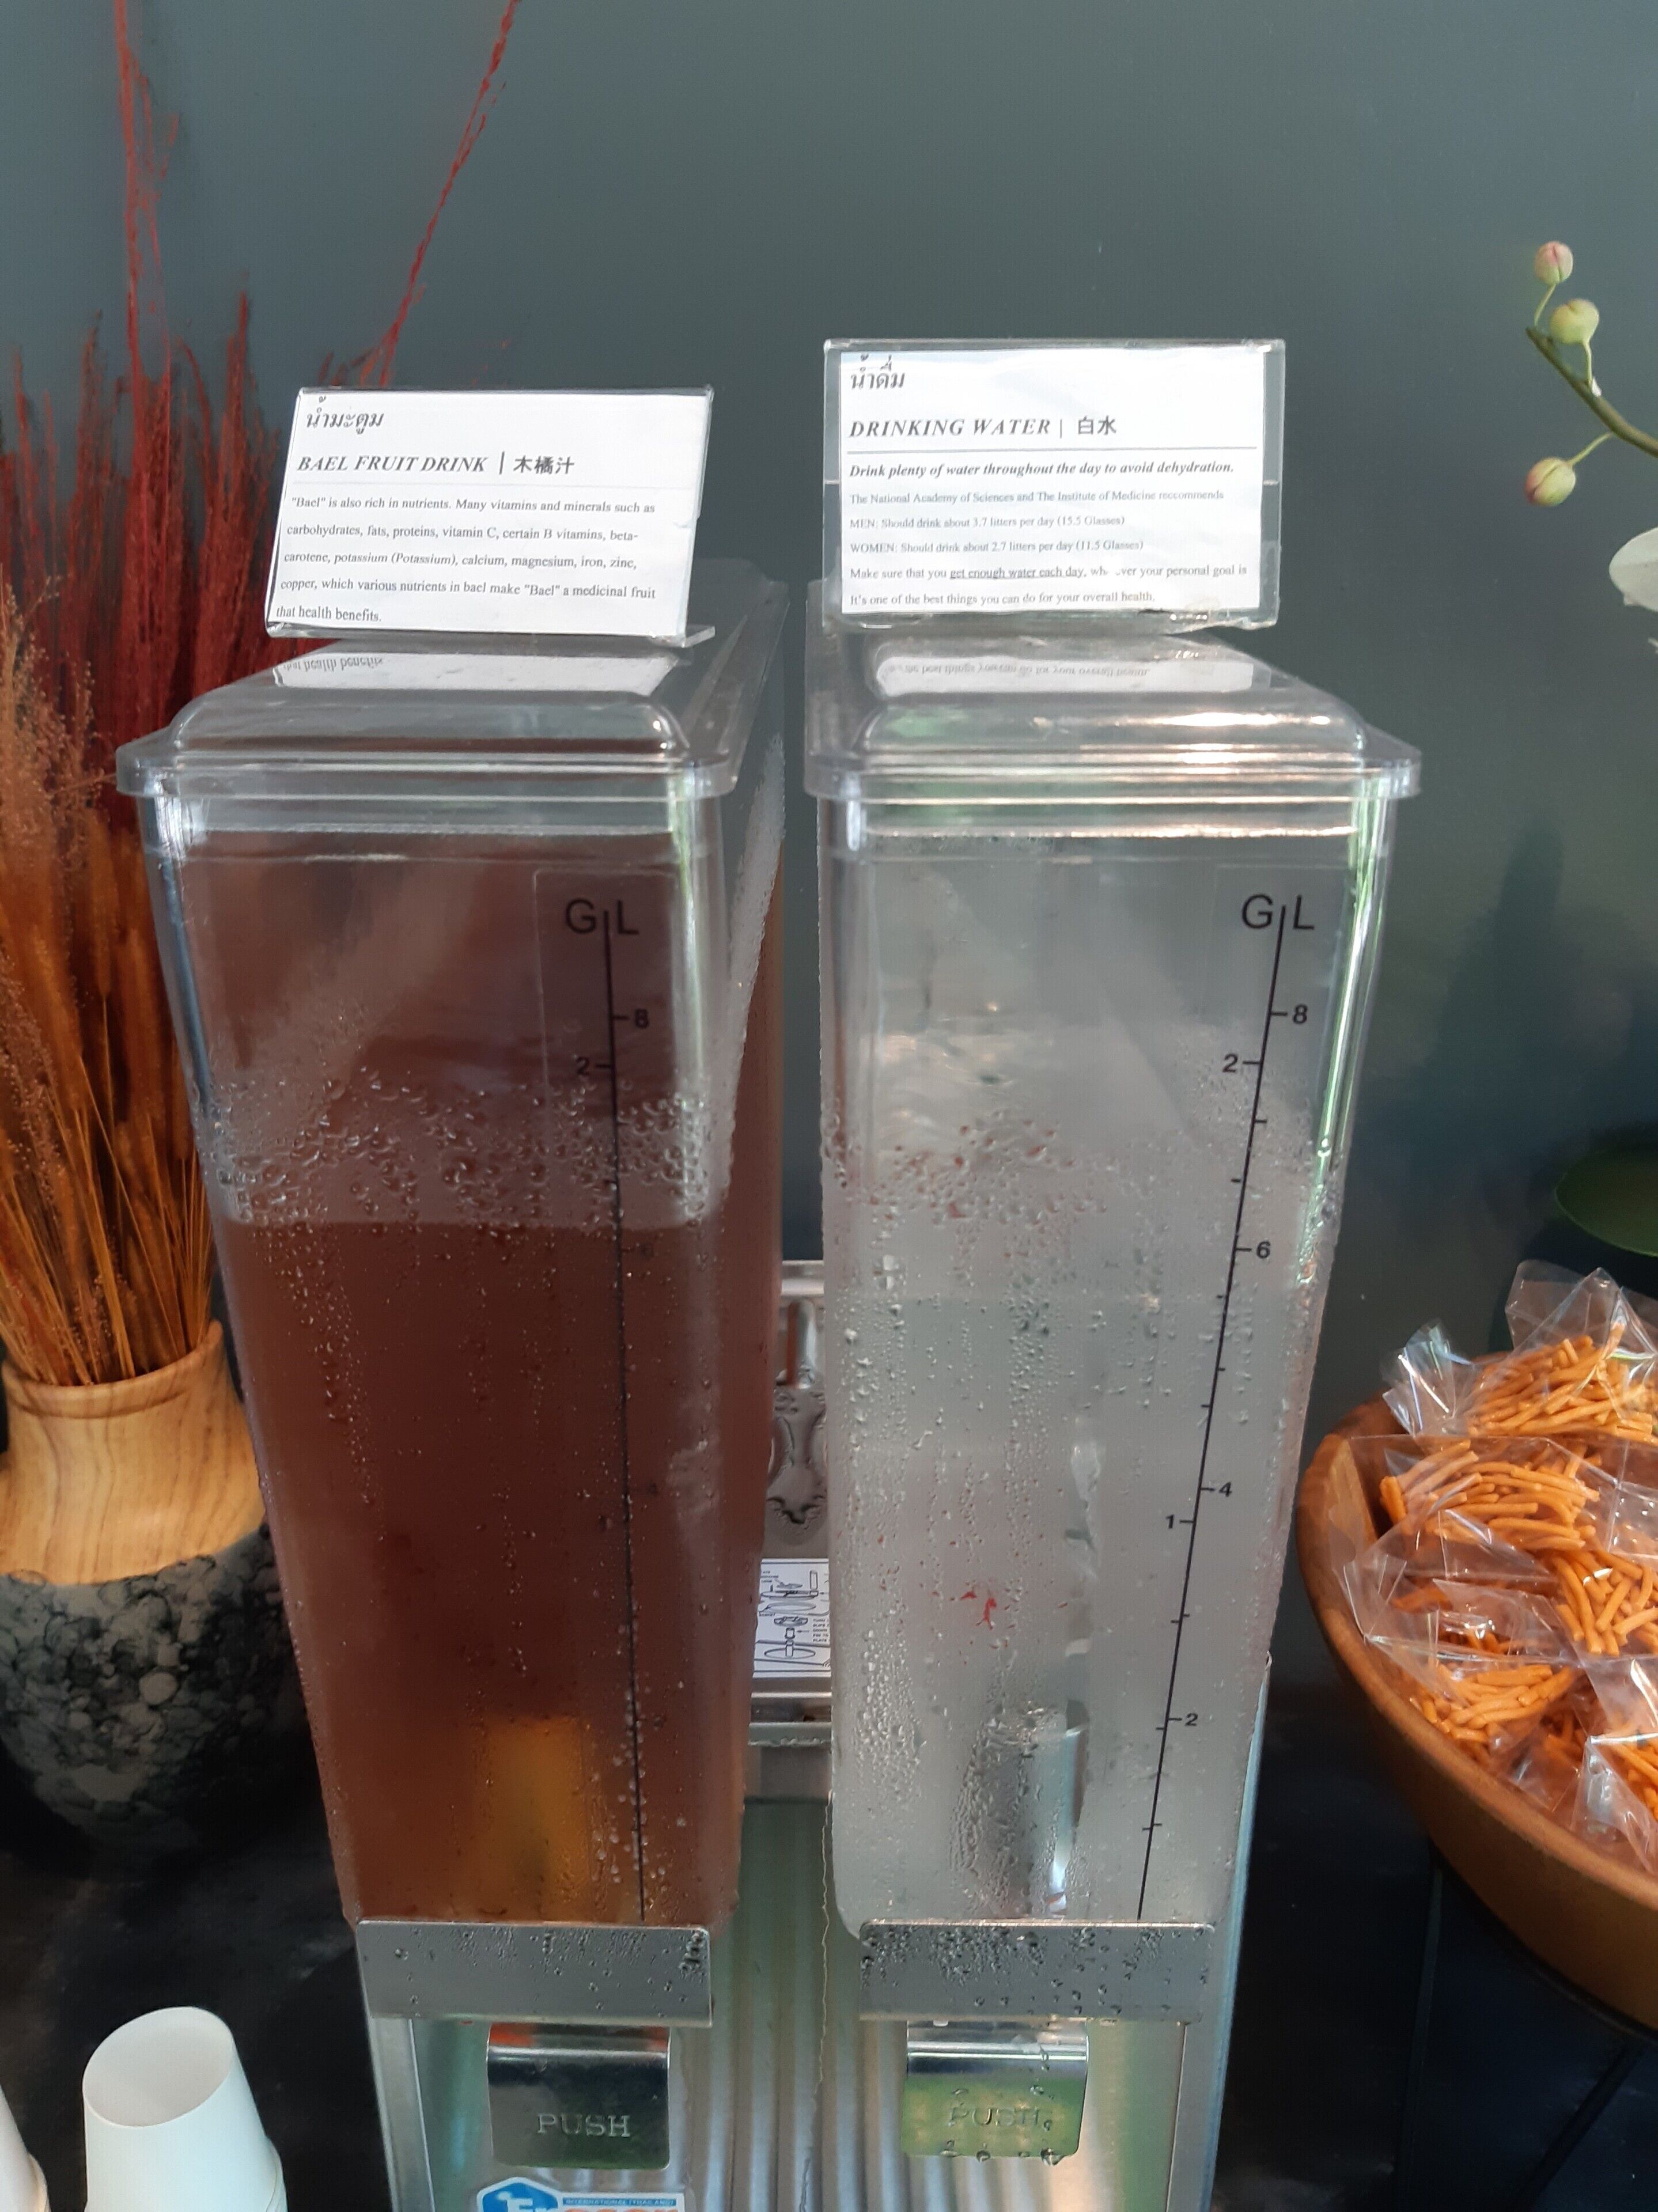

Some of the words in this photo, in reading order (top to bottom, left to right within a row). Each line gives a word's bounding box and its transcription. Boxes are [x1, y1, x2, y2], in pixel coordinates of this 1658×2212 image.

[851, 353, 904, 389] น้ำดื่ม
[307, 396, 384, 435] น้ำมะตูม
[849, 419, 965, 437] DRINKING
[974, 419, 1050, 435] WATER
[1078, 415, 1116, 435] 白水
[297, 456, 348, 471] BAEL
[354, 456, 419, 471] FRUIT
[421, 457, 487, 472] DRINK
[849, 464, 885, 477] Drink
[888, 464, 927, 480] plenty
[929, 464, 945, 479] of
[947, 465, 981, 476] water
[983, 463, 1054, 478] throughout
[1056, 462, 1076, 474] the
[1079, 462, 1101, 477] day
[1104, 464, 1116, 473] to
[1120, 461, 1154, 473] avoid
[1157, 461, 1233, 476] dehydration.
[328, 497, 338, 508] is
[340, 497, 362, 508] also
[364, 497, 385, 508] rich
[388, 497, 399, 508] in
[402, 497, 451, 509] nutrients.
[456, 498, 487, 512] Many
[491, 499, 537, 510] vitamins
[540, 501, 561, 511] and
[563, 500, 611, 512] minerals
[614, 502, 640, 513] such
[643, 505, 655, 513] as
[850, 493, 868, 505] The
[870, 492, 910, 504] National
[913, 492, 957, 505] Academy
[960, 491, 971, 502] of
[973, 492, 1014, 503] Sciences
[1017, 491, 1034, 502] and
[1037, 491, 1054, 502] The
[1058, 491, 1096, 502] Institute
[1099, 491, 1110, 501] of
[1112, 490, 1155, 501] Medicine
[881, 517, 914, 529] Should
[917, 517, 941, 529] drink
[944, 517, 970, 528] about
[1020, 518, 1035, 529] per
[1037, 516, 1054, 528] day
[1084, 516, 1125, 526] Glasses)
[286, 524, 363, 538] carbohydrates,
[367, 525, 389, 538] fats,
[392, 525, 438, 540] proteins,
[442, 525, 483, 538] vitamin
[487, 527, 499, 540] C,
[502, 528, 540, 539] certain
[543, 528, 552, 539] B
[557, 528, 606, 541] vitamins,
[610, 530, 638, 541] beta-
[901, 542, 933, 553] Should
[936, 542, 960, 552] drink
[963, 541, 989, 553] about
[992, 541, 1006, 552] 2.7
[1039, 543, 1053, 554] per
[1056, 540, 1073, 553] day
[1103, 540, 1143, 551] Glasses)
[283, 552, 331, 564] carotene,
[334, 552, 388, 565] potassium
[391, 552, 458, 566] (Potassium),
[461, 554, 508, 567] calcium,
[511, 555, 577, 570] magnesium,
[581, 555, 607, 569] iron,
[610, 556, 637, 570] zinc,
[850, 568, 879, 579] Make
[882, 570, 902, 579] sure
[906, 567, 924, 578] that
[928, 570, 947, 581] you
[950, 569, 966, 581] get
[968, 567, 1006, 581] enough
[1008, 569, 1036, 580] water
[1039, 566, 1064, 578] each
[1065, 566, 1087, 579] day,
[1140, 568, 1163, 578] your
[1167, 565, 1209, 578] personal
[1213, 565, 1234, 578] goal
[1239, 563, 1247, 574] is
[280, 580, 317, 592] copper,
[321, 578, 354, 589] which
[358, 578, 397, 592] various
[400, 580, 447, 592] nutrients
[449, 580, 460, 592] in
[463, 581, 486, 593] bael
[490, 583, 521, 595] make
[562, 587, 569, 596] a
[572, 584, 627, 597] medicinal
[631, 586, 656, 599] fruit
[850, 594, 866, 605] It's
[870, 597, 888, 605] one
[891, 594, 903, 605] of
[905, 593, 920, 605] the
[923, 593, 943, 604] best
[947, 593, 977, 607] things
[981, 596, 999, 607] you
[1002, 596, 1019, 605] can
[1023, 592, 1035, 604] do
[1039, 592, 1053, 603] for
[1057, 594, 1080, 605] your
[1083, 592, 1118, 602] overall
[276, 606, 295, 619] that
[298, 605, 331, 620] health
[336, 607, 381, 622] benefits.
[565, 898, 597, 934] G
[617, 900, 639, 935] L
[1241, 894, 1274, 929] G
[1293, 895, 1315, 930] L
[635, 1009, 649, 1028] 8
[1293, 1004, 1309, 1024] 8
[576, 1057, 590, 1075] 2
[1222, 1054, 1238, 1073] 2
[1256, 1241, 1271, 1259] 6
[1218, 1482, 1233, 1498] 4
[1166, 1514, 1175, 1529] 1
[1185, 1713, 1198, 1726] 2
[536, 2113, 631, 2138] PUSH
